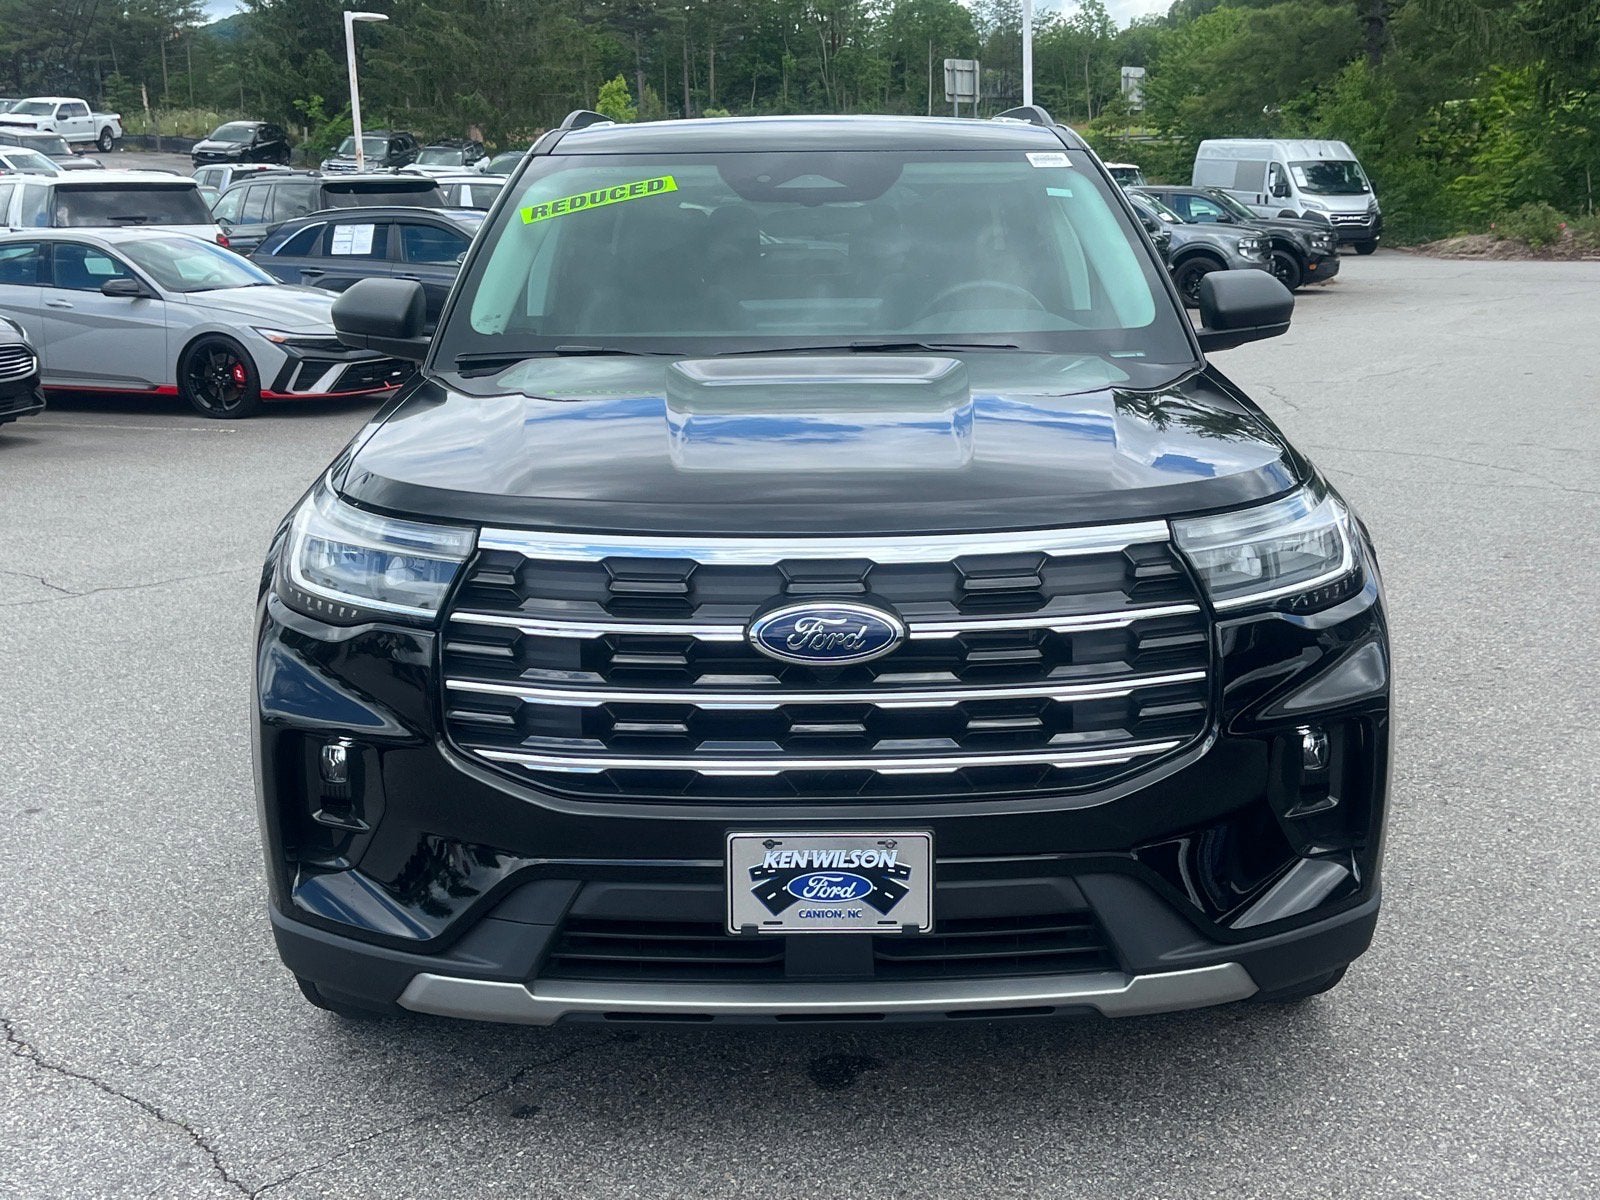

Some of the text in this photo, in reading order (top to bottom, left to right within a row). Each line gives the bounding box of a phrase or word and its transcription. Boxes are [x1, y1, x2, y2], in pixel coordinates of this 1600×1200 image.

[531, 179, 667, 219] REDUCED
[786, 616, 868, 651] Ford
[803, 876, 856, 899] Ford
[798, 909, 863, 920] CANTON, NC
